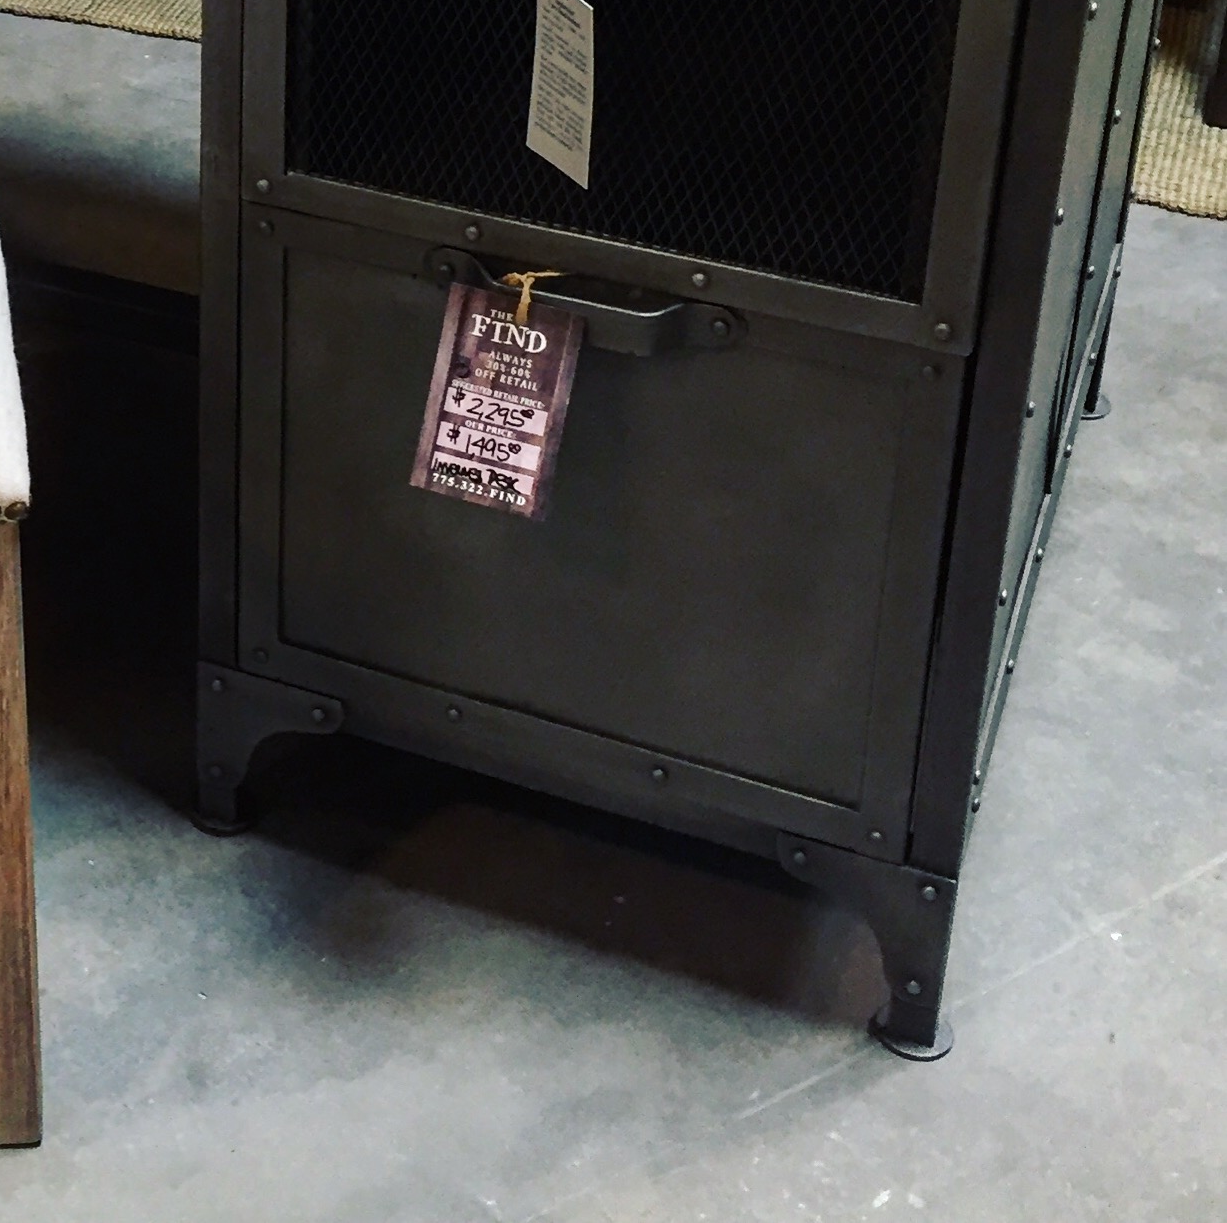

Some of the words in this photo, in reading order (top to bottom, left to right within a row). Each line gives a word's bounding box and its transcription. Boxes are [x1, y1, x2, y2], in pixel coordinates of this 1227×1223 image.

[490, 309, 514, 322] THE
[469, 314, 547, 353] FIND
[488, 350, 533, 369] ALWAYS
[474, 368, 496, 381] OFF
[499, 374, 538, 392] RETAIL
[493, 389, 519, 403] RETAIL
[465, 419, 485, 431] OUR
[432, 473, 527, 506] 775.322.FIND
